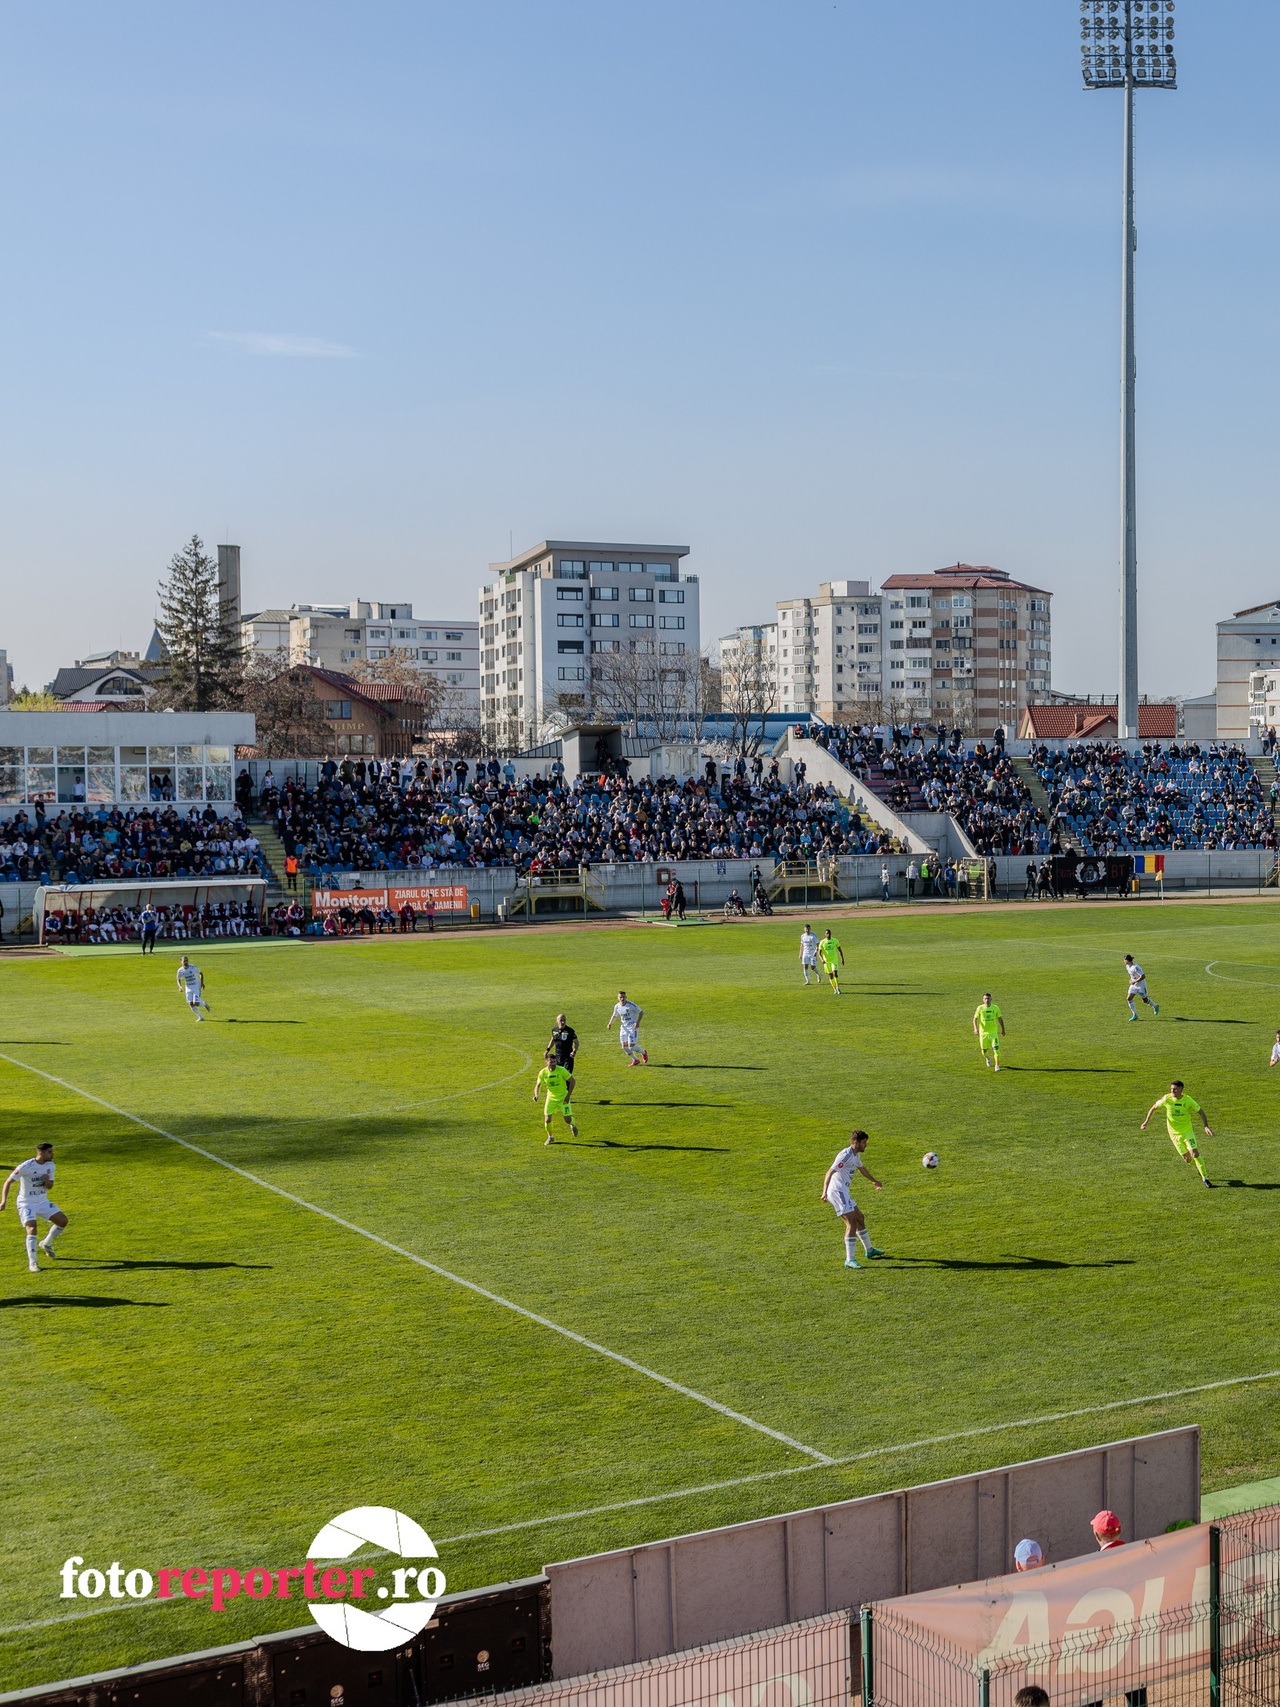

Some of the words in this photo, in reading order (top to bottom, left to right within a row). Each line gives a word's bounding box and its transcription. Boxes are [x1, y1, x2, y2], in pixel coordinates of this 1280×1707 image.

[315, 890, 389, 908] Monitorul
[394, 889, 419, 899] ZIARUL
[454, 888, 464, 897] DE
